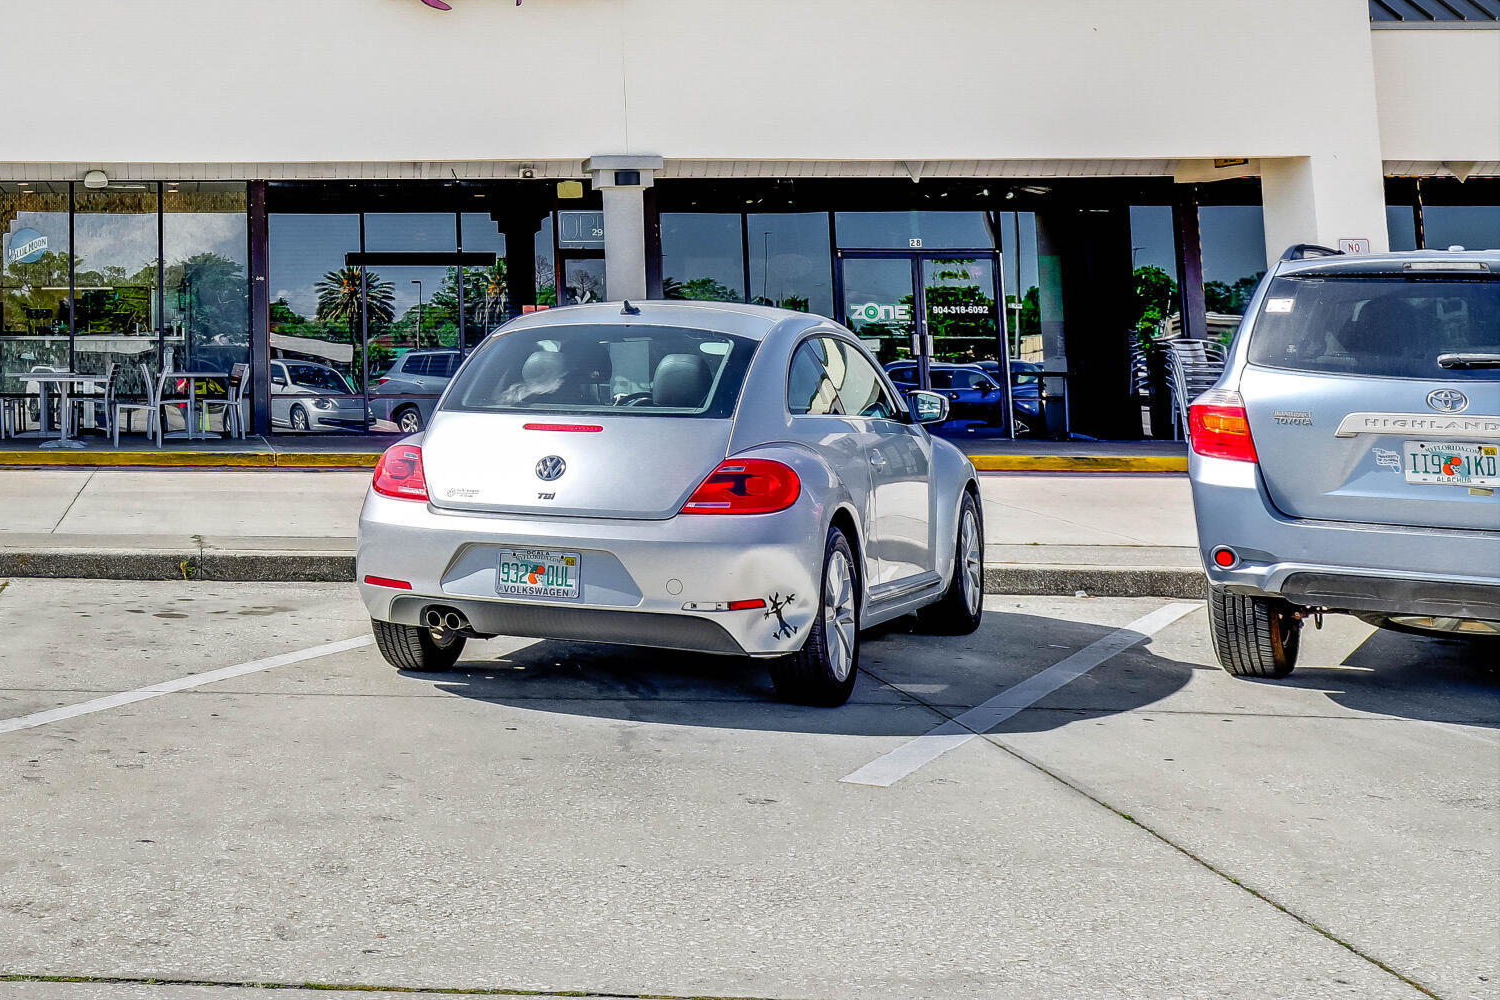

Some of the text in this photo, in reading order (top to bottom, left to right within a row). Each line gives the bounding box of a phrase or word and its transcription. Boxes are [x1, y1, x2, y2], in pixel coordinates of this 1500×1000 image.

[592, 228, 603, 236] 29
[910, 239, 921, 247] 28
[1348, 243, 1361, 253] NO
[932, 306, 989, 314] 904-318-6092
[1274, 417, 1313, 426] TOYOTA
[501, 562, 573, 587] 932 QUL
[504, 585, 569, 597] VOLKSWAGEN
